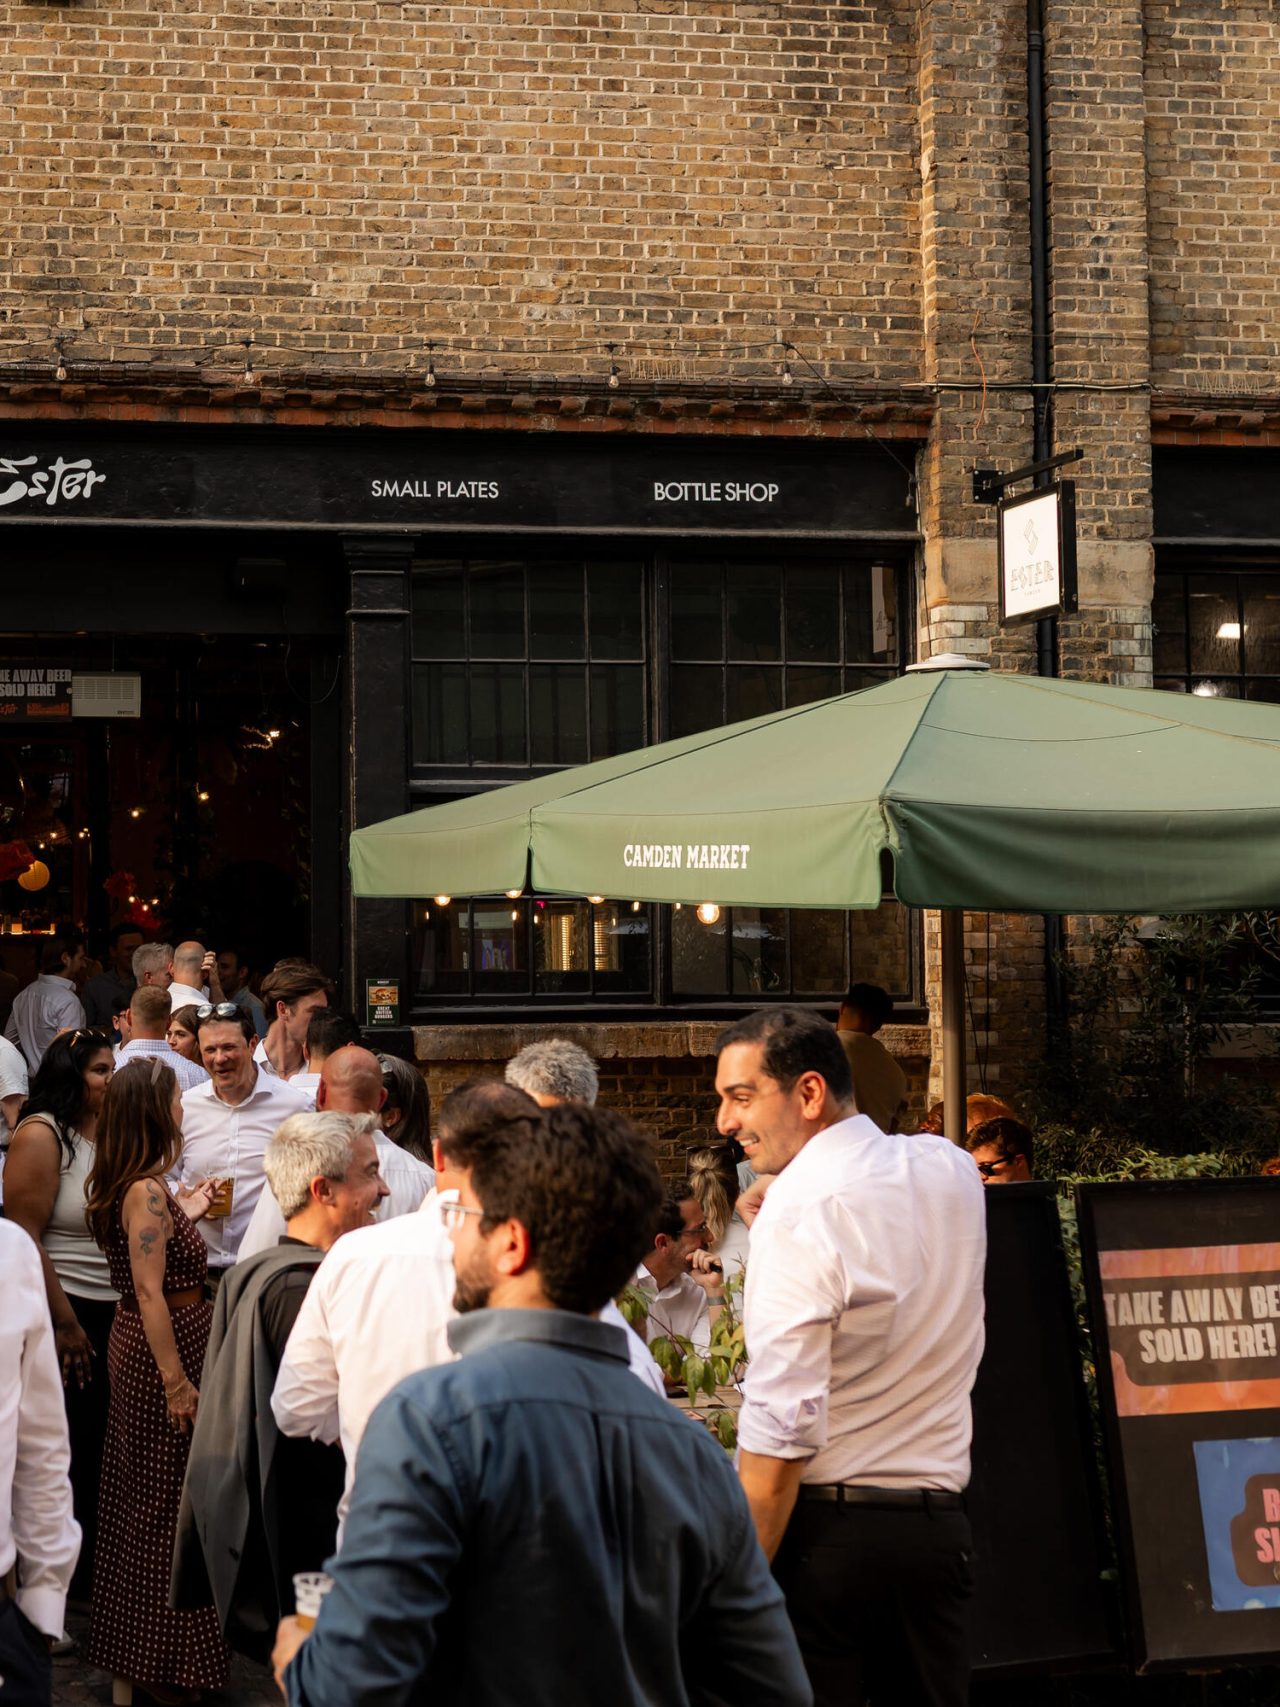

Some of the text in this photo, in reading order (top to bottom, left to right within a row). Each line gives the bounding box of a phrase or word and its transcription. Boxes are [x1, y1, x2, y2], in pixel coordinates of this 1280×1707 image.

[371, 480, 500, 499] SMALL PLATES
[653, 482, 779, 503] BOTTLE SHOP
[1010, 560, 1055, 592] ESTER
[12, 669, 45, 683] AWAY
[47, 669, 72, 683] BEER
[26, 683, 56, 697] HERE!
[623, 844, 750, 869] CAMDEN MARKET
[1103, 1291, 1165, 1327] TAKE
[1170, 1287, 1243, 1323] AWAY
[1138, 1322, 1277, 1364] SOLD HERE!
